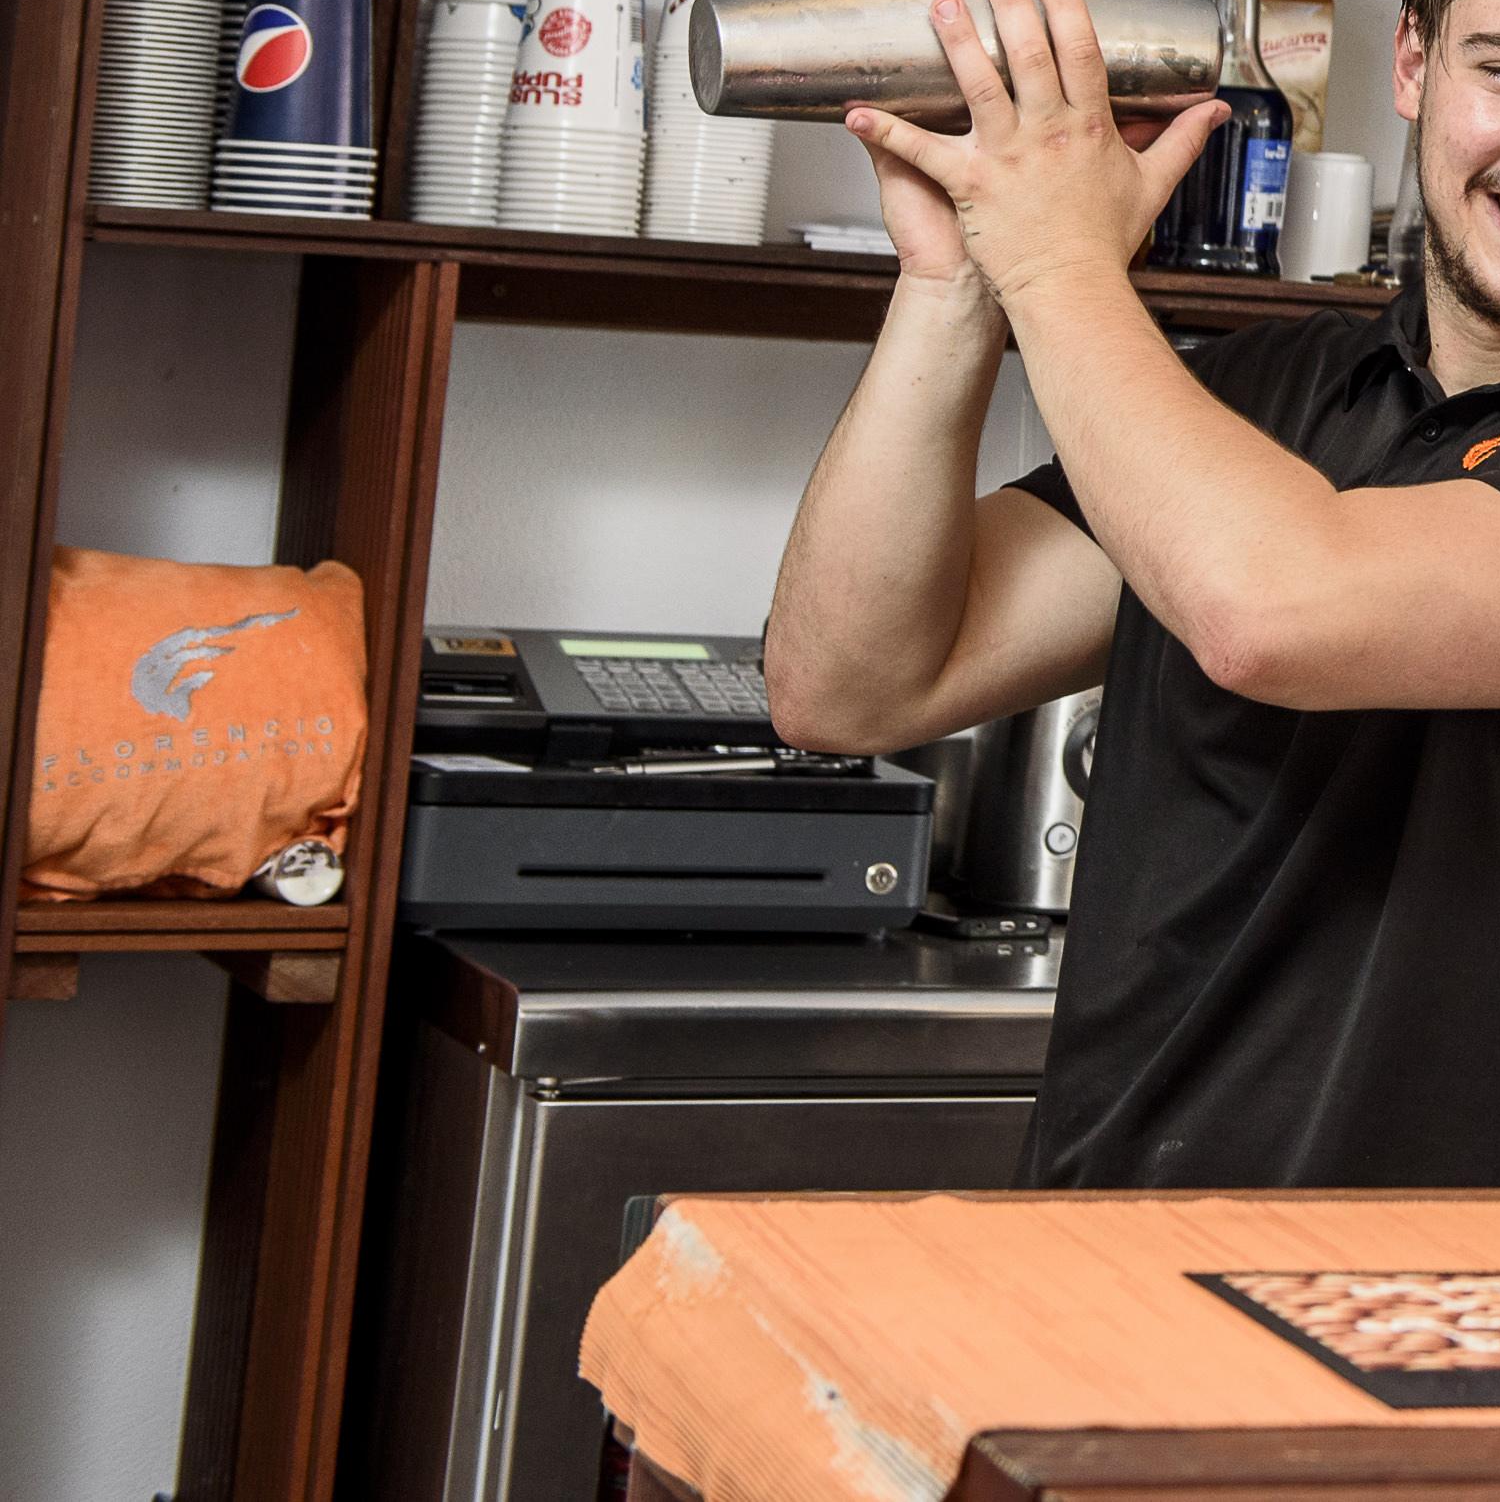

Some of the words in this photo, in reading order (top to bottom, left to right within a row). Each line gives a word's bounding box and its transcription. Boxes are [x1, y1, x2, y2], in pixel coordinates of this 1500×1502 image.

[1262, 30, 1329, 54] zucarera
[513, 70, 584, 89] PUPP
[42, 716, 334, 773] FLORENCIO
